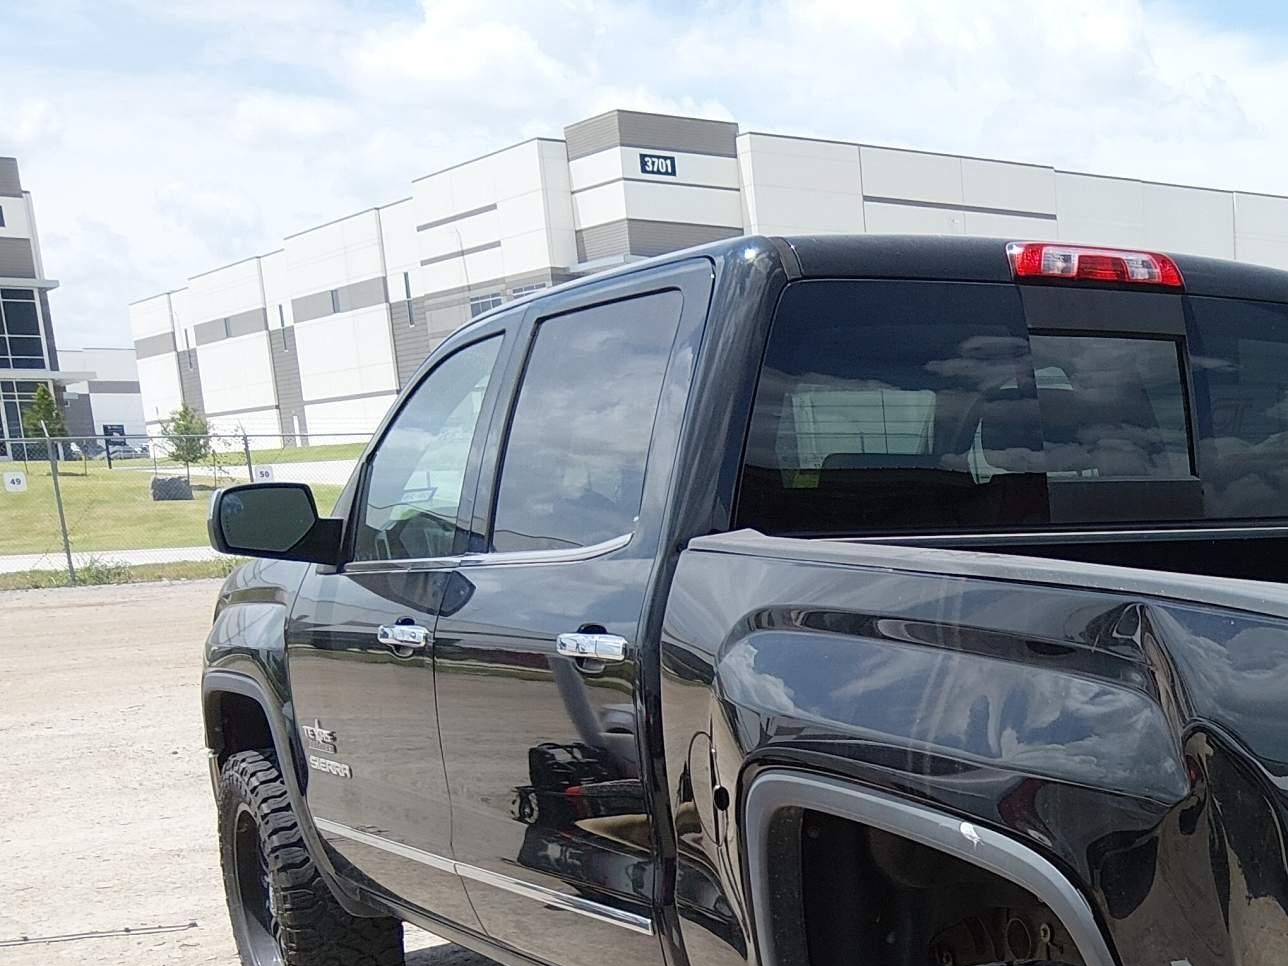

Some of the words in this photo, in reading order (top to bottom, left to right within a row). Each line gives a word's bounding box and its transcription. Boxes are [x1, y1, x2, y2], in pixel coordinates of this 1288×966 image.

[644, 157, 672, 174] 3701
[259, 470, 270, 478] 50
[309, 754, 352, 779] SIERRA
